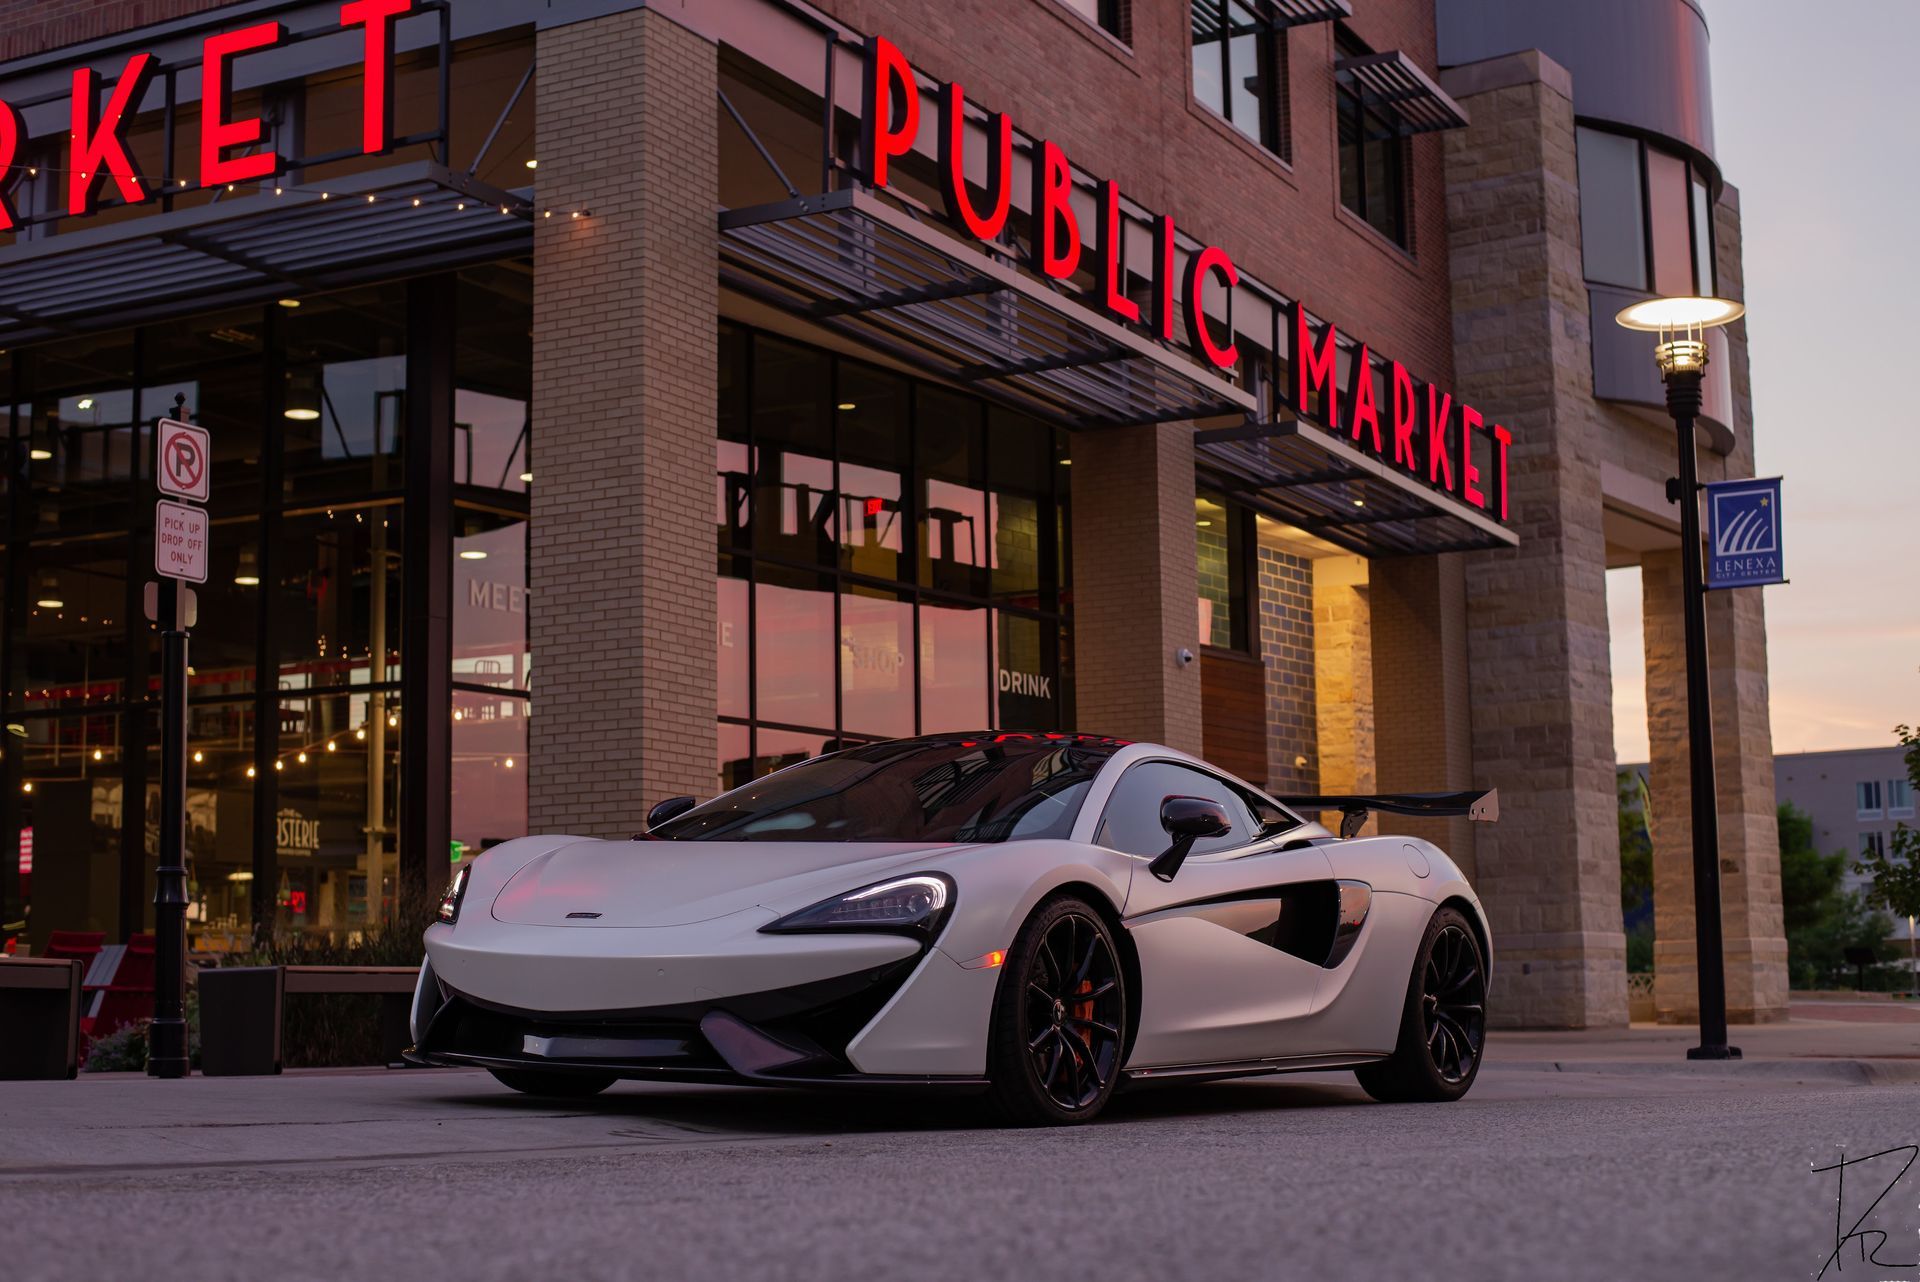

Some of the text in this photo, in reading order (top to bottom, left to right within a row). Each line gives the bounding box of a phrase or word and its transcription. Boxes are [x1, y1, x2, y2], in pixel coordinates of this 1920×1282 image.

[0, 0, 413, 231] KET
[873, 35, 1513, 521] PUBLIC MARKET
[164, 517, 201, 535] PICK UP
[161, 533, 203, 551] DROP OFF
[170, 551, 193, 565] ONLY
[1716, 557, 1776, 572] LENEXA
[999, 668, 1051, 700] DRINK
